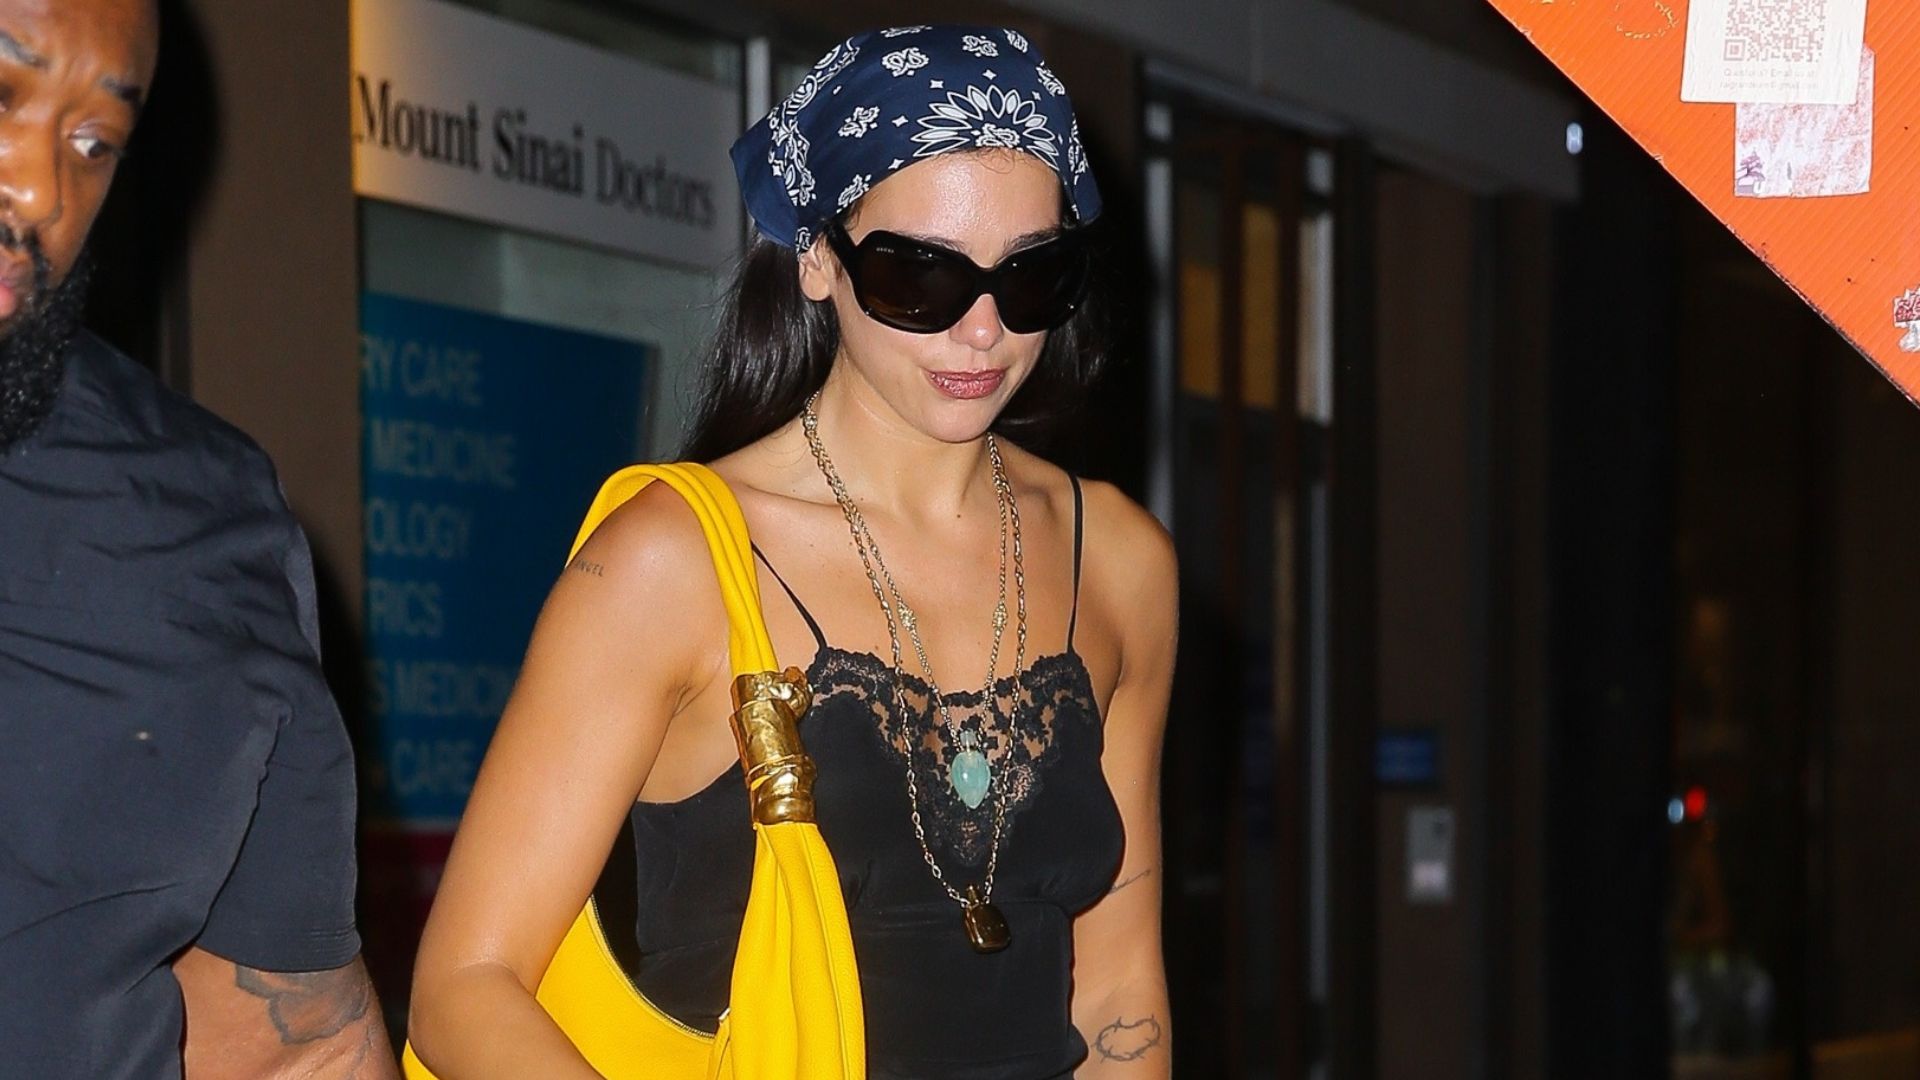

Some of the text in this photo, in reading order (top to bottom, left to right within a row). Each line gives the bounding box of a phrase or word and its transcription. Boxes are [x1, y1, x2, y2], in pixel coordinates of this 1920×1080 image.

[356, 75, 717, 230] Mount Sinai Doctors
[400, 340, 483, 407] CARE
[371, 417, 517, 490] MEDICINE
[391, 738, 475, 797] CARE
